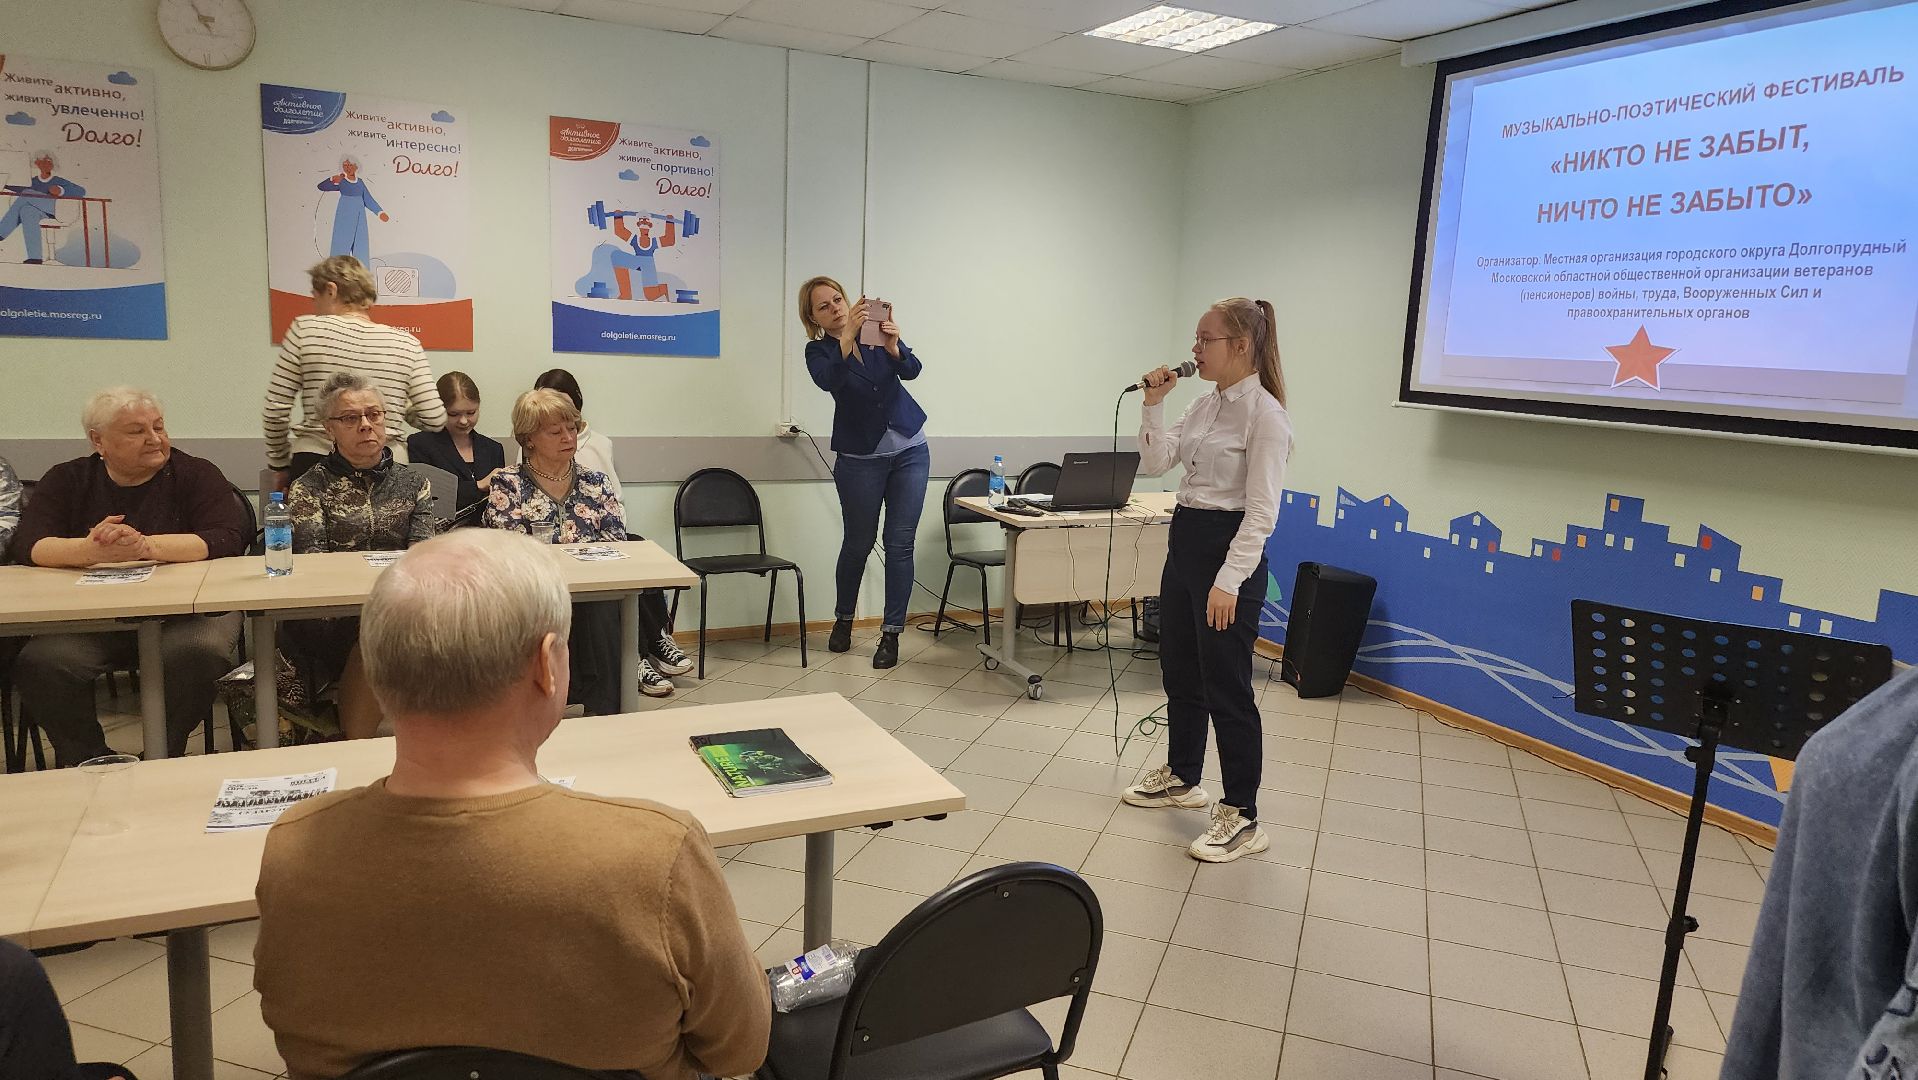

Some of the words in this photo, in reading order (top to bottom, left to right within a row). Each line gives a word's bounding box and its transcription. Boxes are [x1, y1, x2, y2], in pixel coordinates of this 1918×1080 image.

[5, 72, 53, 87] Живите
[54, 83, 126, 101] активно,
[5, 94, 52, 105] живите
[51, 104, 144, 121] увлеченно!
[1502, 83, 1756, 139] МУЗЫКАЛЬНО-ПОЭТИЧЕСКИЙ
[1763, 65, 1905, 99] ФЕСТИВАЛЬ
[61, 122, 142, 147] Долго!
[345, 109, 387, 123] Живите
[387, 121, 446, 136] активно,
[347, 129, 387, 140] живите
[386, 139, 461, 154] интересно!
[618, 137, 653, 149] Живите
[653, 147, 702, 160] активно,
[1550, 142, 1646, 174] «НИКТО
[1654, 138, 1690, 163] НЕ
[1699, 123, 1809, 159] ЗАБЫТ,
[392, 155, 459, 178] Долго!
[618, 155, 651, 164] живите
[651, 163, 714, 177] спортивно!
[656, 177, 712, 199] Долго!
[1537, 196, 1619, 224] НИЧТО
[1627, 193, 1662, 218] НЕ
[1670, 182, 1813, 215] ЗАБЫТО»
[1543, 253, 1588, 266] Местная
[1590, 251, 1662, 266] организация
[1665, 247, 1737, 262] городского
[1741, 245, 1785, 260] округа
[1789, 239, 1907, 258] Долгопрудный
[1491, 271, 1550, 283] Московской
[1553, 269, 1611, 282] областной
[1613, 266, 1701, 282] общественной
[1704, 266, 1789, 281] организации
[1794, 265, 1873, 280] ветеранов
[1520, 288, 1595, 303] (пенсионеров)
[1598, 287, 1638, 301] войны,
[1642, 289, 1680, 302] труда,
[1683, 286, 1776, 302] Вооруженных
[1780, 284, 1808, 299] Сил
[1813, 288, 1822, 299] и
[0, 308, 102, 321] olgoletie.mosreg.ru
[1567, 307, 1694, 319] правоохранительных
[1696, 308, 1750, 321] органов
[601, 331, 676, 341] dolgoletie.mosreg.ru
